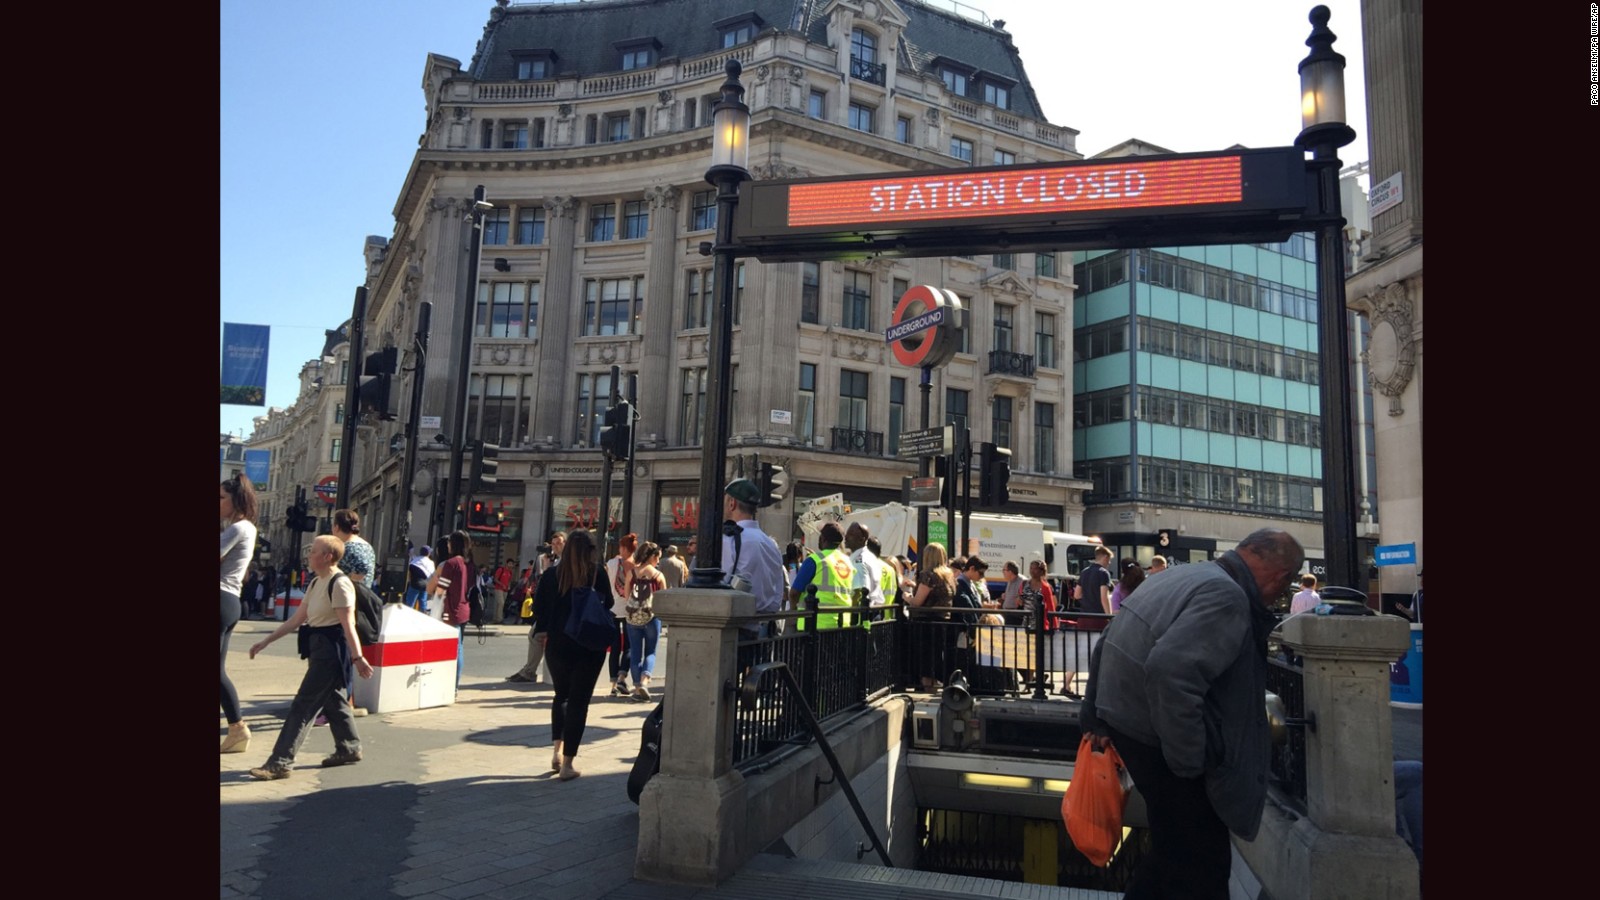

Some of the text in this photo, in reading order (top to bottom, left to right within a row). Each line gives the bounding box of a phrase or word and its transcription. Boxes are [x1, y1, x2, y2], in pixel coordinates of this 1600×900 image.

[869, 169, 1147, 213] STATION CLOSED
[1371, 181, 1391, 199] OXFORD
[887, 312, 942, 340] UNDERGROUND
[928, 524, 945, 532] nice
[980, 540, 1017, 550] Westminster
[1160, 532, 1169, 547] 3
